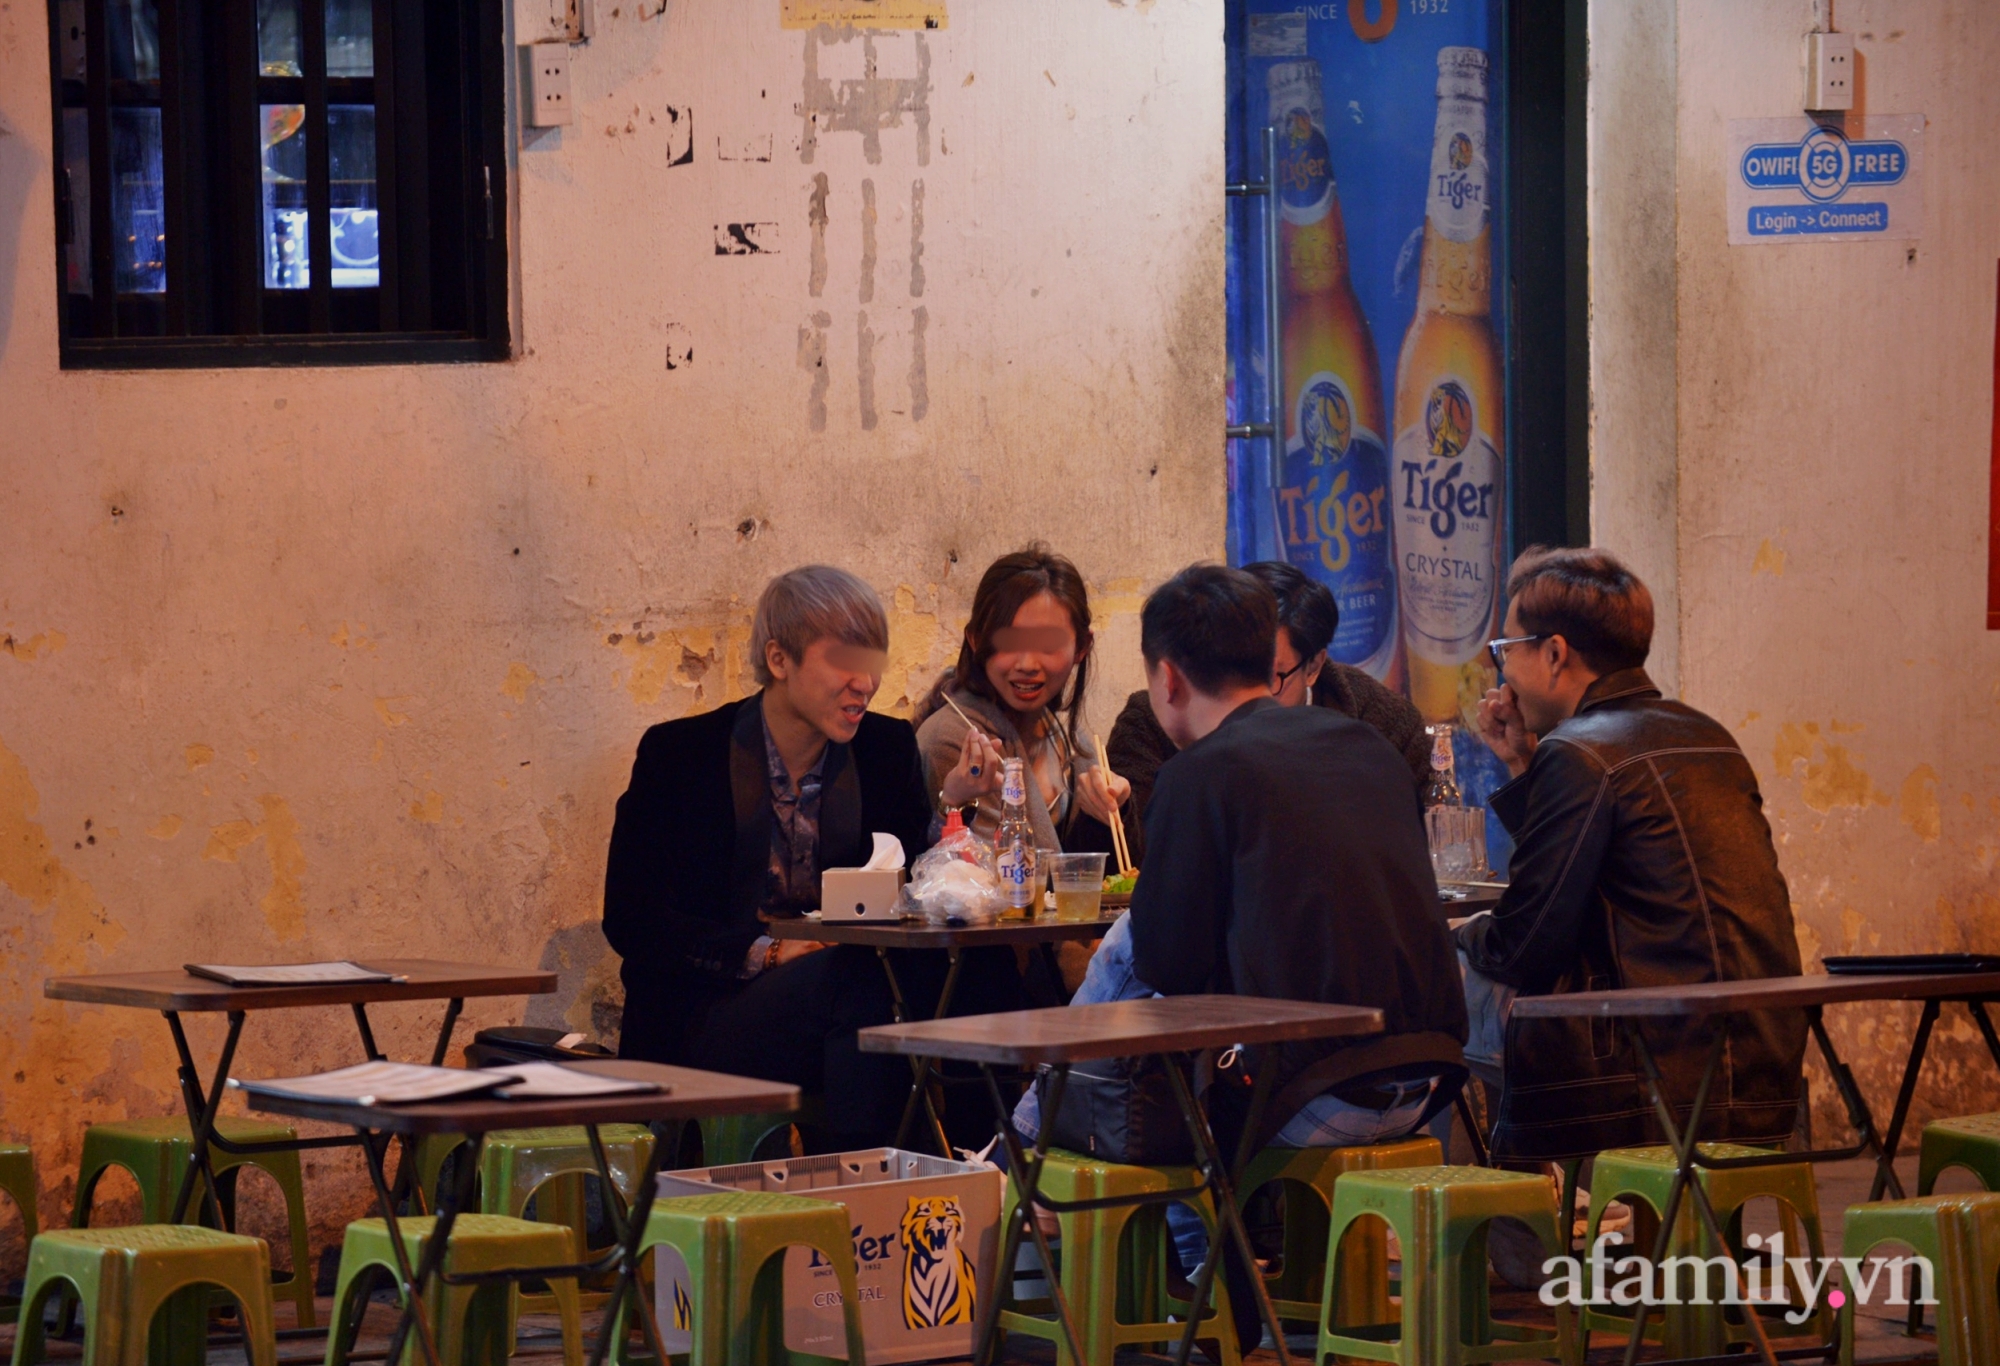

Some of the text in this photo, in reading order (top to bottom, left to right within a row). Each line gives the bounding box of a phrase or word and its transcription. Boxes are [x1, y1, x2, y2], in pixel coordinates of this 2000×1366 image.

[1410, 0, 1449, 14] 1932
[1281, 150, 1325, 191] Tiger
[1746, 153, 1900, 176] OWIFI 5G FREE
[1437, 171, 1482, 209] Tiger
[1756, 212, 1797, 233] Login
[1819, 210, 1881, 228] Connect
[1401, 459, 1493, 539] Tiger
[1280, 470, 1385, 570] Tiger
[1405, 552, 1482, 581] CRYSTAL
[1349, 594, 1376, 610] BEER
[1001, 863, 1035, 885] Tiger
[813, 1285, 887, 1309] CRYTAL
